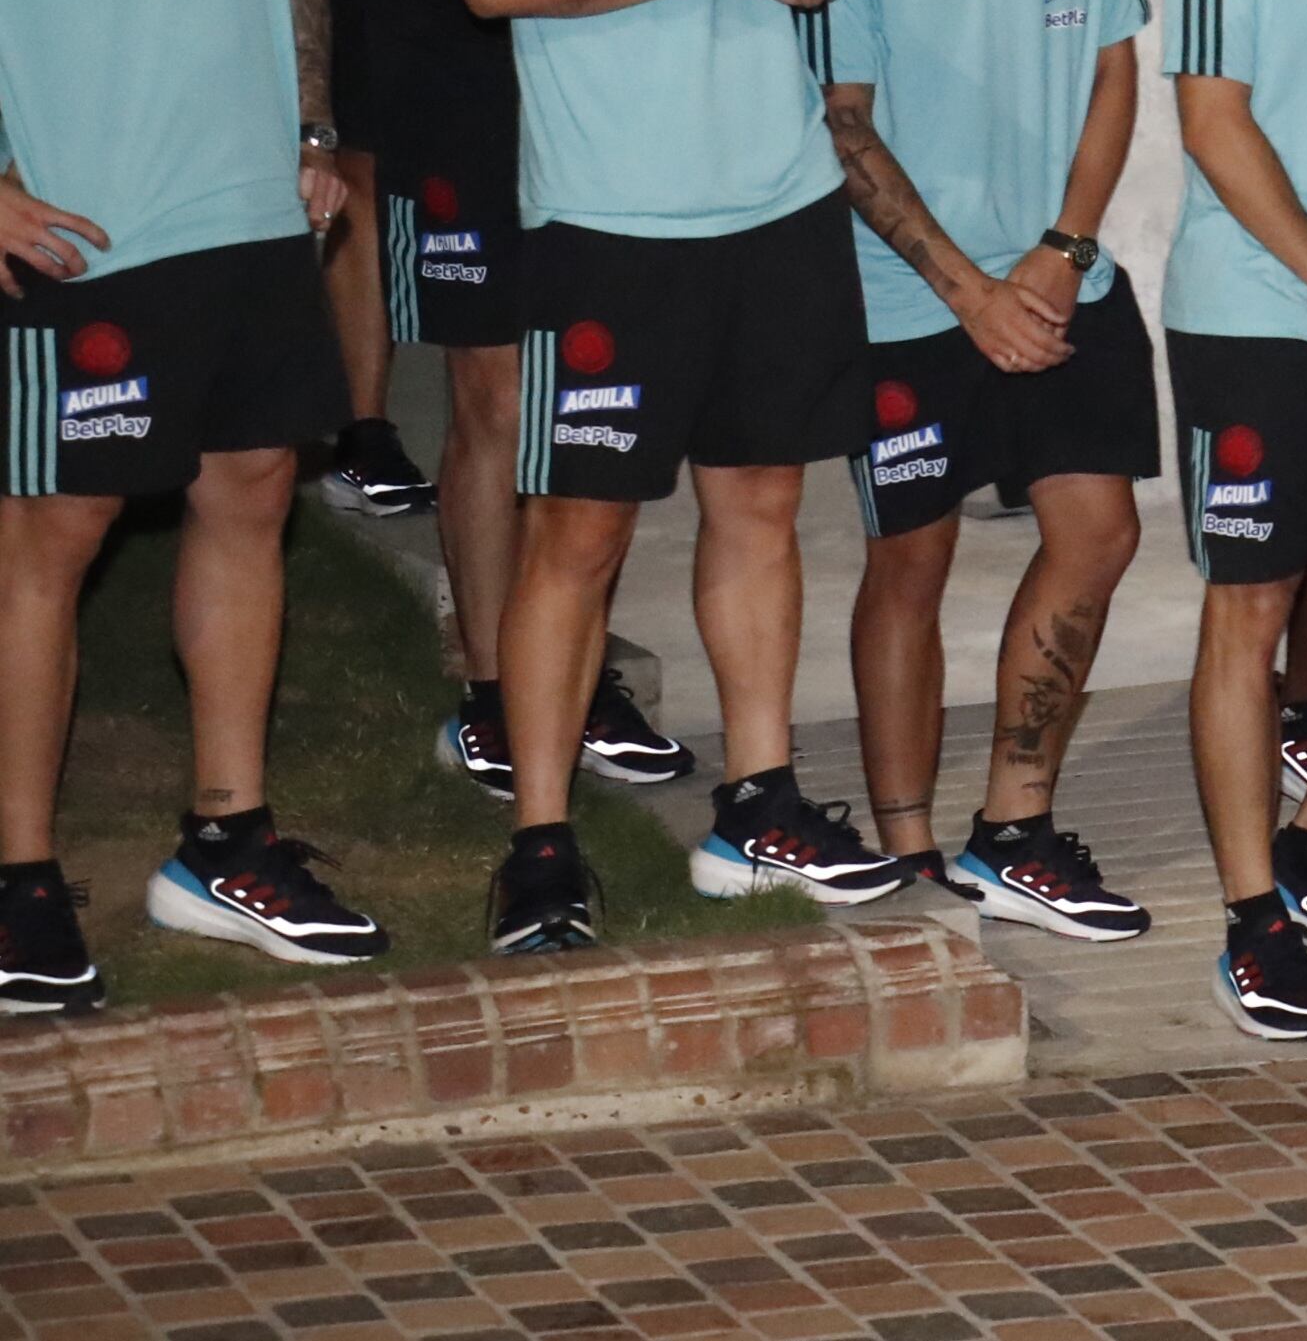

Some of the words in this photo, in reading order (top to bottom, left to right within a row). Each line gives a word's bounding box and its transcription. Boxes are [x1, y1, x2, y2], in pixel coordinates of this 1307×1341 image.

[1045, 10, 1088, 29] BetPla
[425, 233, 476, 253] AGUILA
[422, 260, 487, 284] BetPlay
[65, 380, 142, 416] AGUILA
[563, 387, 635, 413] AGUILA
[61, 414, 151, 441] BetPlay
[555, 424, 638, 452] BetPlay
[876, 427, 939, 465] AGUILA
[873, 457, 948, 486] BetPlay
[1209, 483, 1268, 508] AGUILA
[1203, 513, 1274, 542] BetPlay
